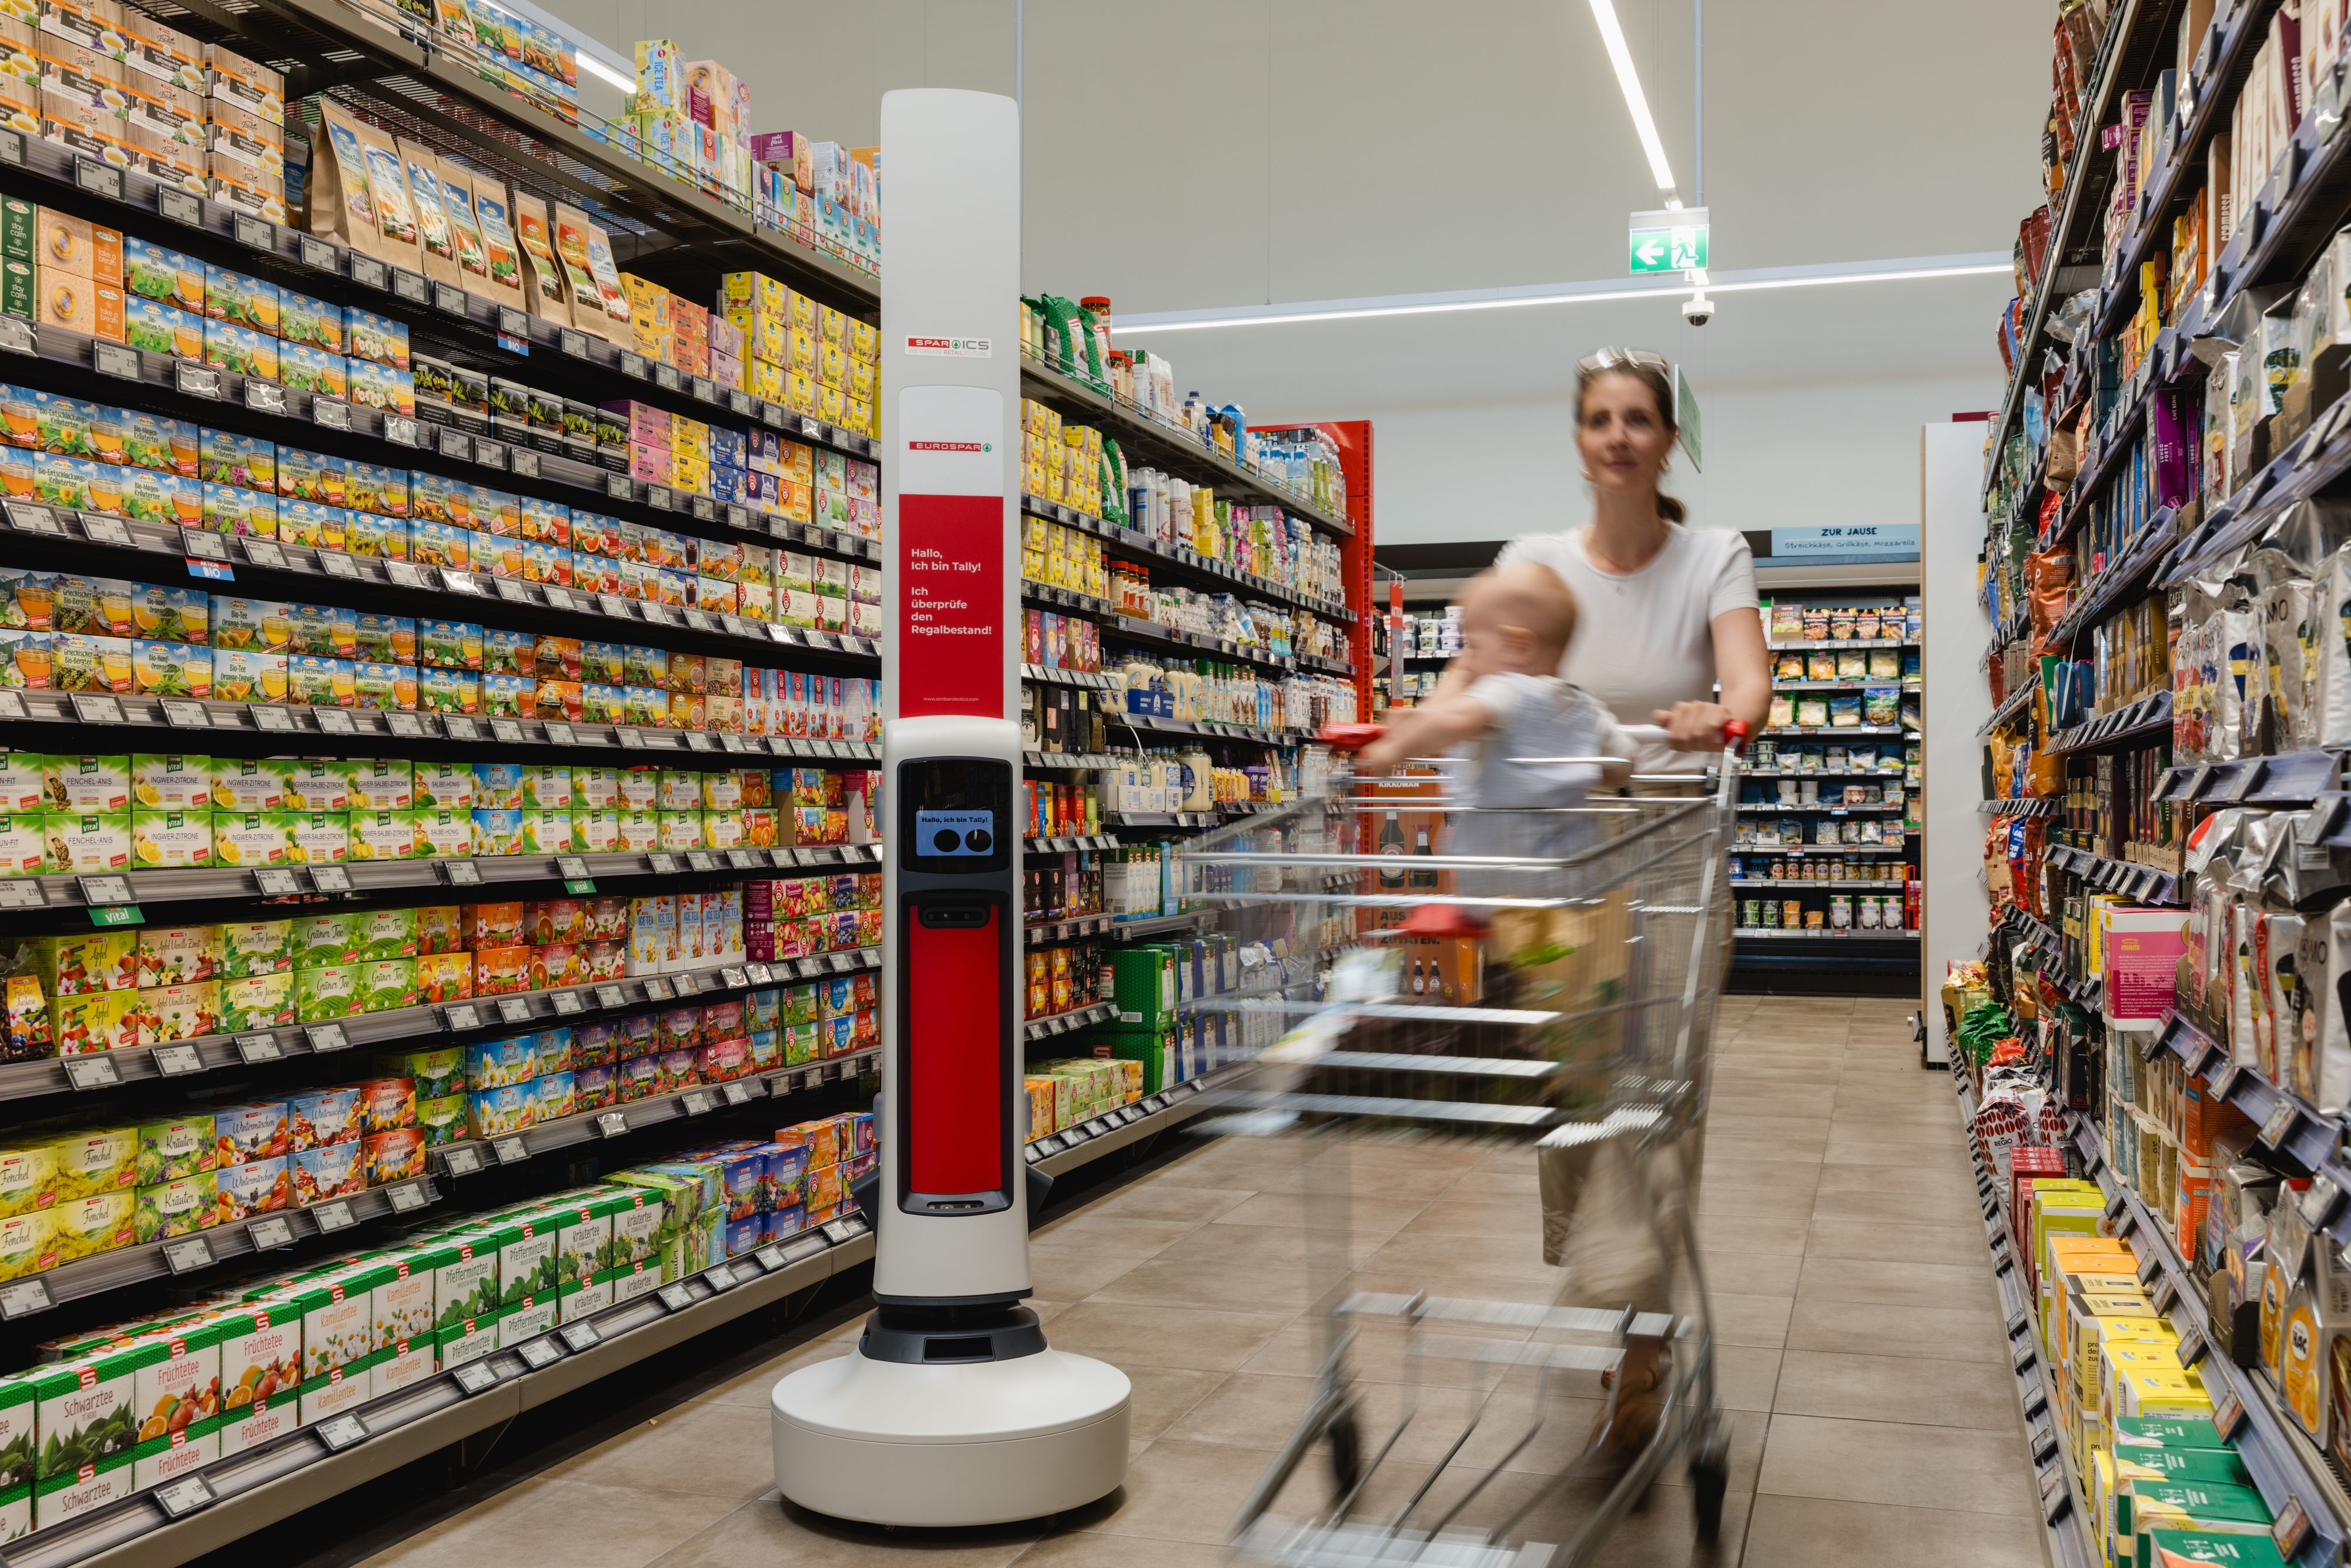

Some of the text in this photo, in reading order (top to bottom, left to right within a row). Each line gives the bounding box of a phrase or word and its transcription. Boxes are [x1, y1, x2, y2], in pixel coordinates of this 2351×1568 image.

[654, 61, 664, 91] ICE TEA
[108, 177, 118, 187] 3.29
[189, 206, 198, 215] 3.29
[11, 222, 24, 232] stay
[10, 229, 26, 239] calm
[99, 249, 111, 259] take
[326, 253, 334, 261] 2.99
[99, 256, 116, 267] breath
[142, 263, 168, 277] Melissen-Tee
[962, 340, 989, 350] ICS
[39, 407, 89, 424] Bio-Entschlackungs-
[50, 417, 78, 429] Kräutertee
[133, 432, 159, 444] Kräutertee
[213, 448, 237, 460] Kräutertee
[912, 549, 943, 559] Hallo,
[203, 567, 221, 579] BIO
[912, 561, 981, 573] Ich bin Tally!
[63, 589, 92, 598] Griechischer
[912, 587, 928, 595] Ich
[63, 597, 91, 606] Bio-Bergtee
[147, 598, 168, 607] Bio-Hanf-
[912, 599, 967, 611] überprüfe
[231, 611, 247, 619] Bio-Tee
[912, 612, 933, 621] den
[222, 619, 256, 629] Orange-Ingwer
[912, 625, 992, 635] Regalbestand!
[82, 763, 97, 773] Vital
[168, 763, 182, 771] Vital
[489, 773, 507, 785] Kamille
[105, 908, 129, 923] Vital
[646, 915, 654, 926] TEA
[691, 911, 699, 921] TEA
[307, 924, 344, 947] Grüner Tee
[369, 919, 403, 940] Grüner Tee
[158, 938, 200, 955] Apfel Vanille Zimt
[238, 932, 280, 950] Grüner Tee Jasmin
[89, 943, 108, 967] Apfel
[494, 957, 517, 977] Hagebutte
[584, 1034, 606, 1047] Waldbeere
[186, 1053, 196, 1061] 1.59
[501, 1048, 518, 1062] Kamille
[102, 1065, 112, 1073] 1.59
[312, 1102, 347, 1124] Winterausflug
[233, 1118, 274, 1134] Wintermärchen
[166, 1135, 193, 1150] Kräuter
[84, 1148, 111, 1165] Fenchel
[1, 1164, 29, 1185] Fenchel
[738, 1172, 751, 1182] BEEREN
[627, 1212, 652, 1228] Kräutertee
[572, 1225, 600, 1243] Kräutertee
[196, 1247, 207, 1255] 1.59
[510, 1241, 548, 1263] Pfefferminztee
[446, 1262, 488, 1285] Pfefferminztee
[386, 1281, 421, 1302] Kamillentee
[574, 1291, 601, 1309] Kräutertee
[320, 1305, 357, 1328] Kamillentee
[244, 1332, 283, 1356] Früchtetee
[452, 1335, 490, 1359] Pfefferminztee
[158, 1359, 199, 1386] Früchtetee
[386, 1357, 421, 1381] Kamillentee
[81, 1382, 97, 1393] BUDGET
[317, 1384, 356, 1409] Kamillentee
[64, 1388, 113, 1419] Schwarztee
[242, 1415, 279, 1441] Früchtetee
[348, 1422, 358, 1431] 1.29
[159, 1448, 200, 1476] Früchtetee
[192, 1483, 205, 1495] 1.59
[62, 1480, 111, 1512] Schwarztee
